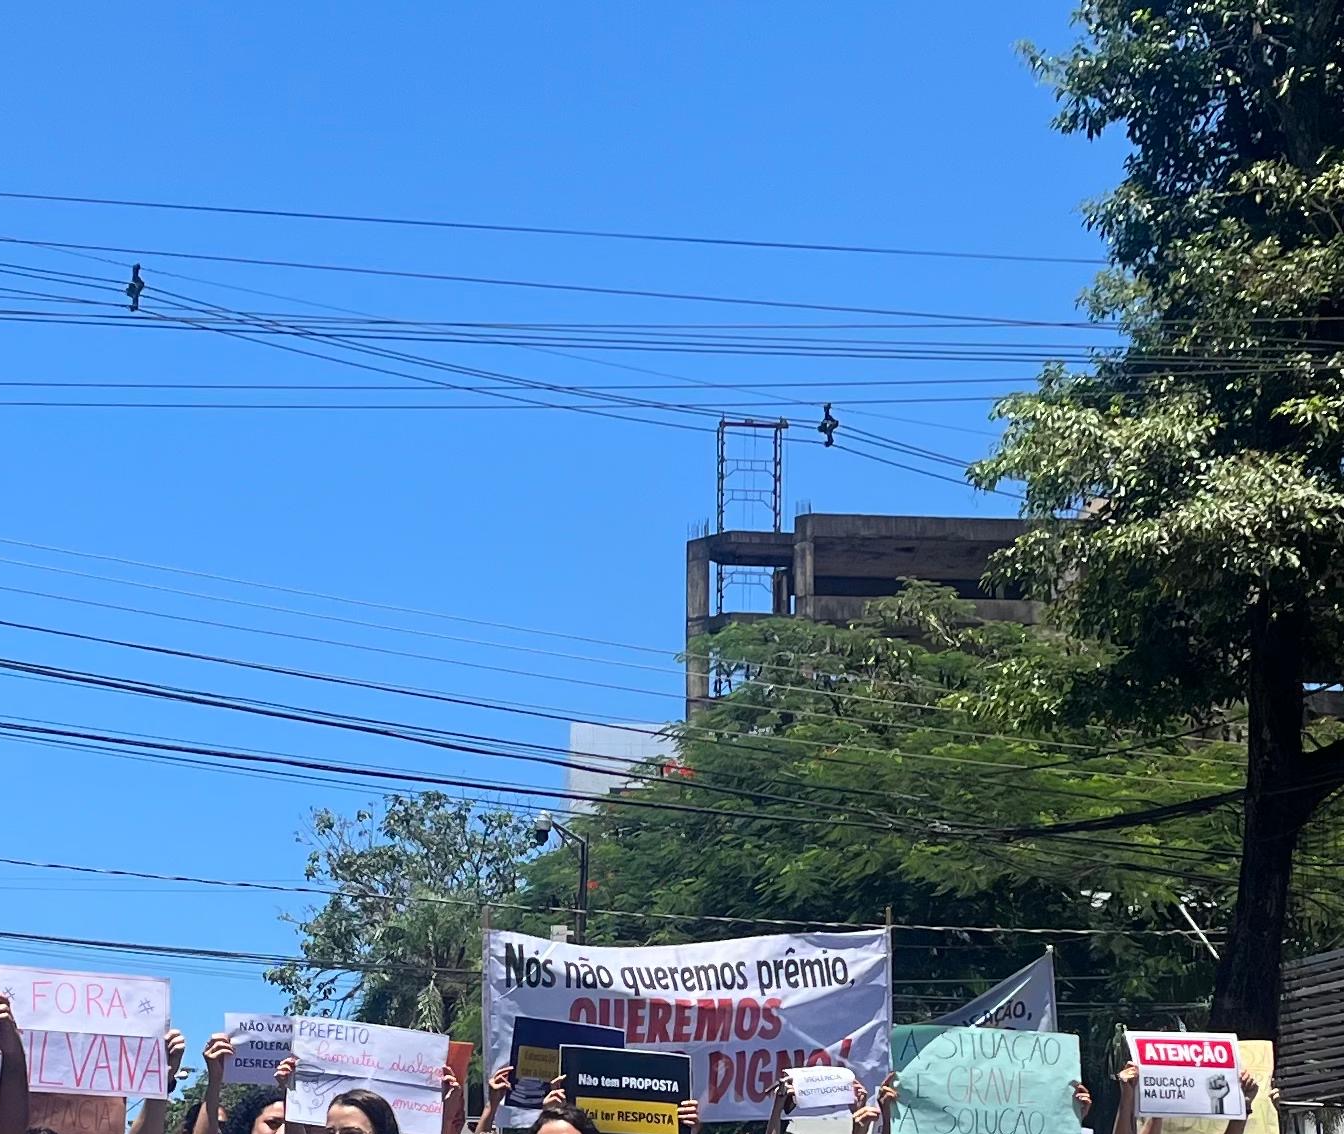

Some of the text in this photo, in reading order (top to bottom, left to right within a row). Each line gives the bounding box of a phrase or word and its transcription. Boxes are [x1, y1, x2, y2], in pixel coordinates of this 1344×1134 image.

[505, 942, 856, 996] Nós não queremos prêmio,
[32, 981, 128, 1019] FORA
[239, 1020, 293, 1034] NÃO VAM
[299, 1020, 369, 1044] PREFEITO
[250, 1041, 293, 1051] TOLERA
[900, 1029, 920, 1061] A
[1144, 1041, 1229, 1067] ATENÇÃO
[578, 1073, 679, 1093] Não tem PROPOSTA
[916, 1063, 1036, 1106] É GRAVE
[1143, 1075, 1196, 1089] EDUCAÇÃO
[1144, 1089, 1158, 1099] NA
[601, 1110, 614, 1121] ter
[617, 1111, 674, 1126] RESPOSTA
[898, 1104, 920, 1134] A
